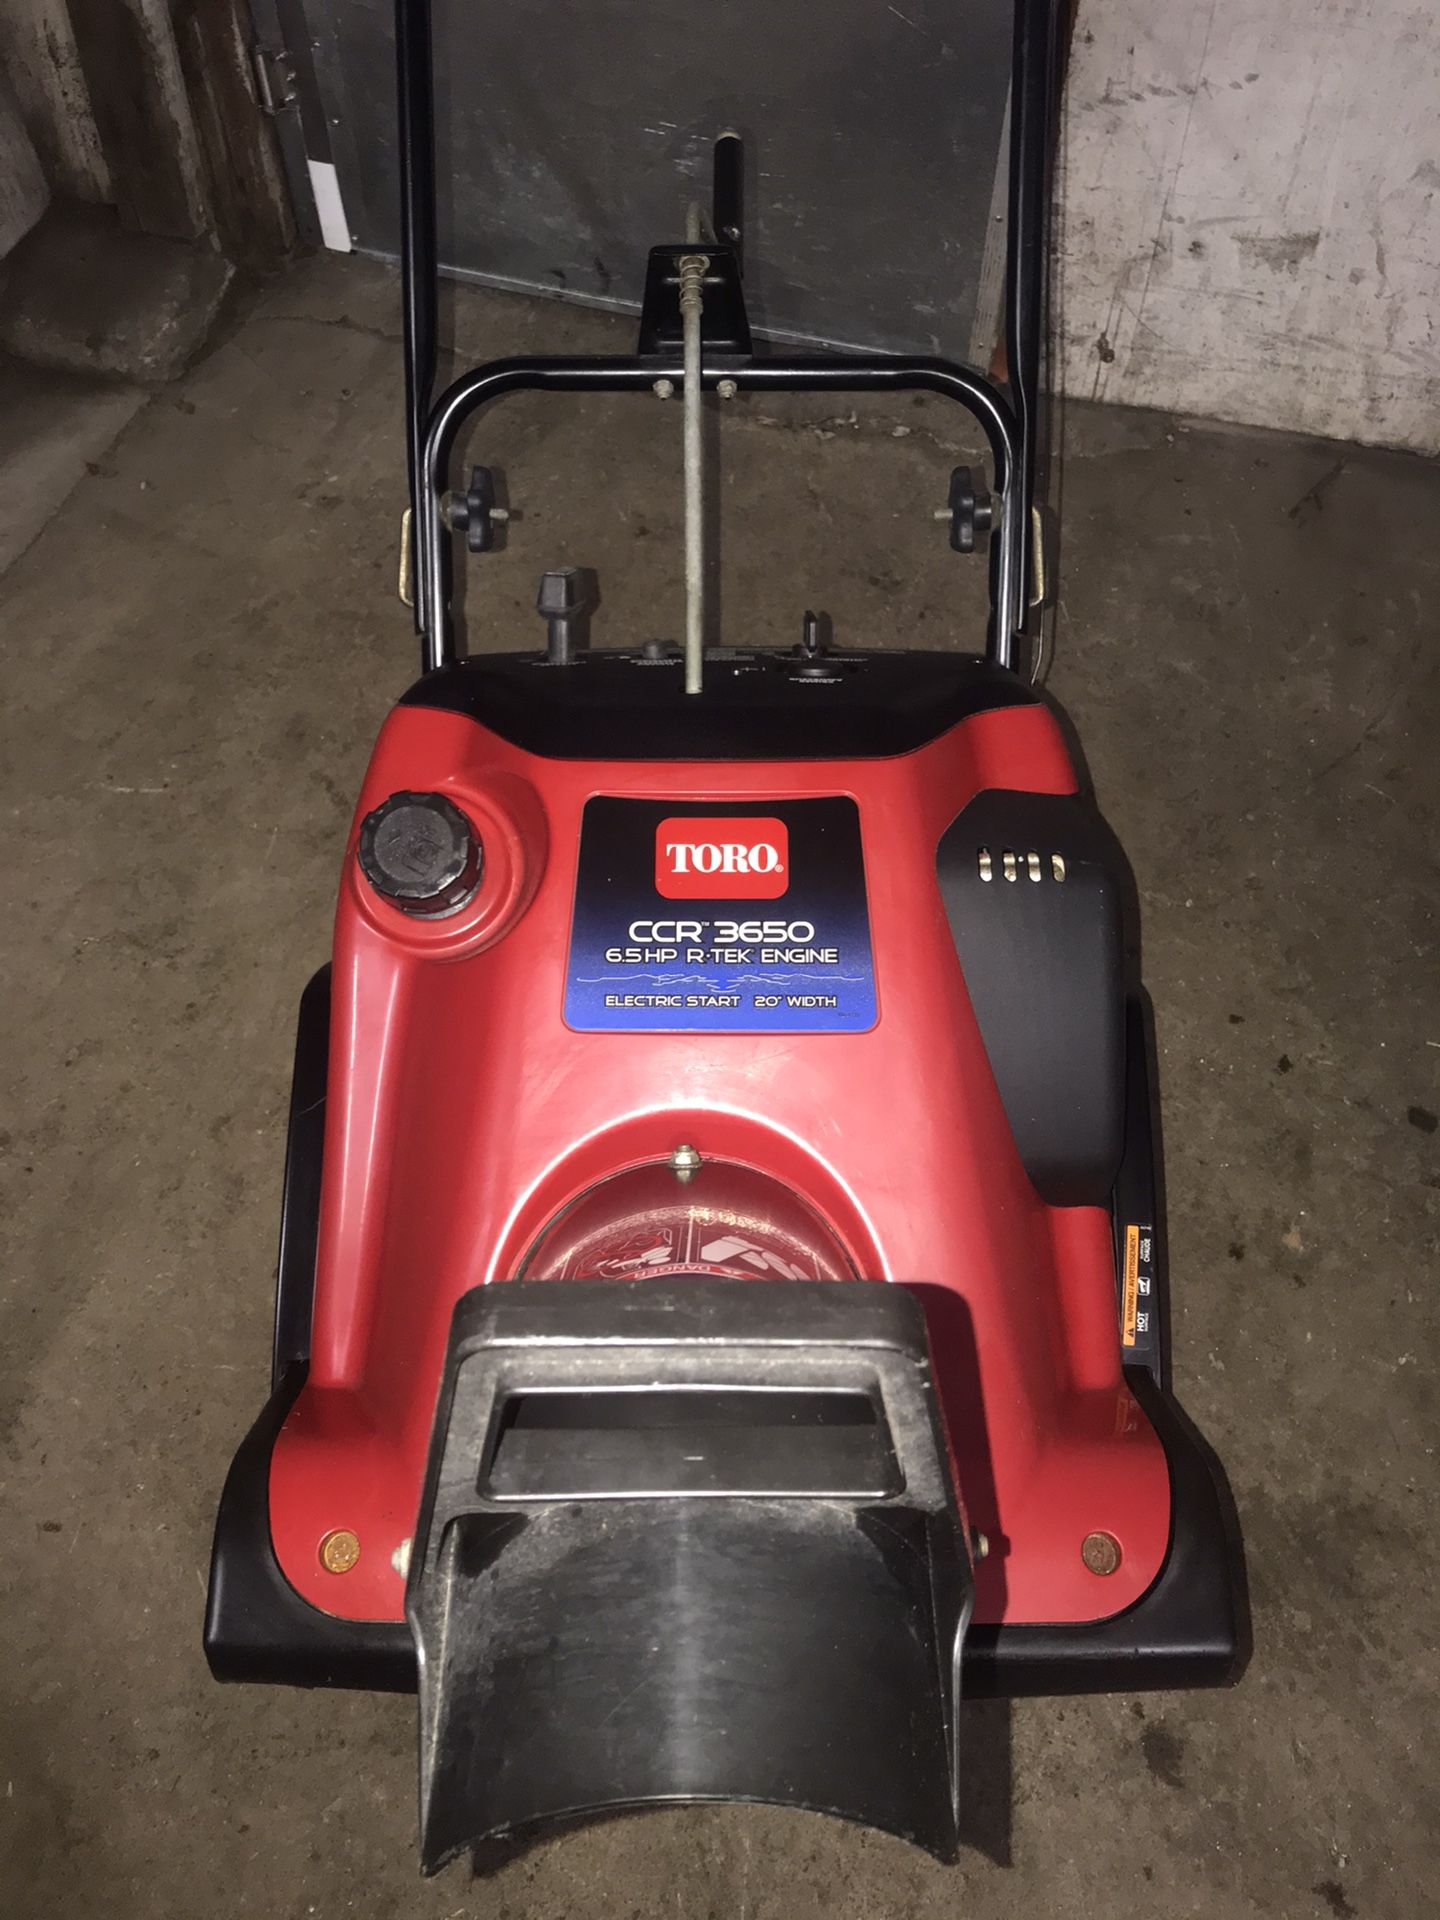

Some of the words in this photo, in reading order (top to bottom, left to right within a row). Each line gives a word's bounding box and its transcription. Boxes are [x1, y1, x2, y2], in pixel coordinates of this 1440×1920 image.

[713, 921, 815, 943] 3650
[761, 948, 838, 964] ENGINE
[605, 995, 682, 1007] ELECTRIC
[686, 995, 741, 1007] START
[786, 995, 837, 1007] WIDTH
[1128, 1234, 1136, 1287] AVERTISSEMENT
[634, 1265, 711, 1279] DANGER
[1127, 1292, 1135, 1323] WARNING
